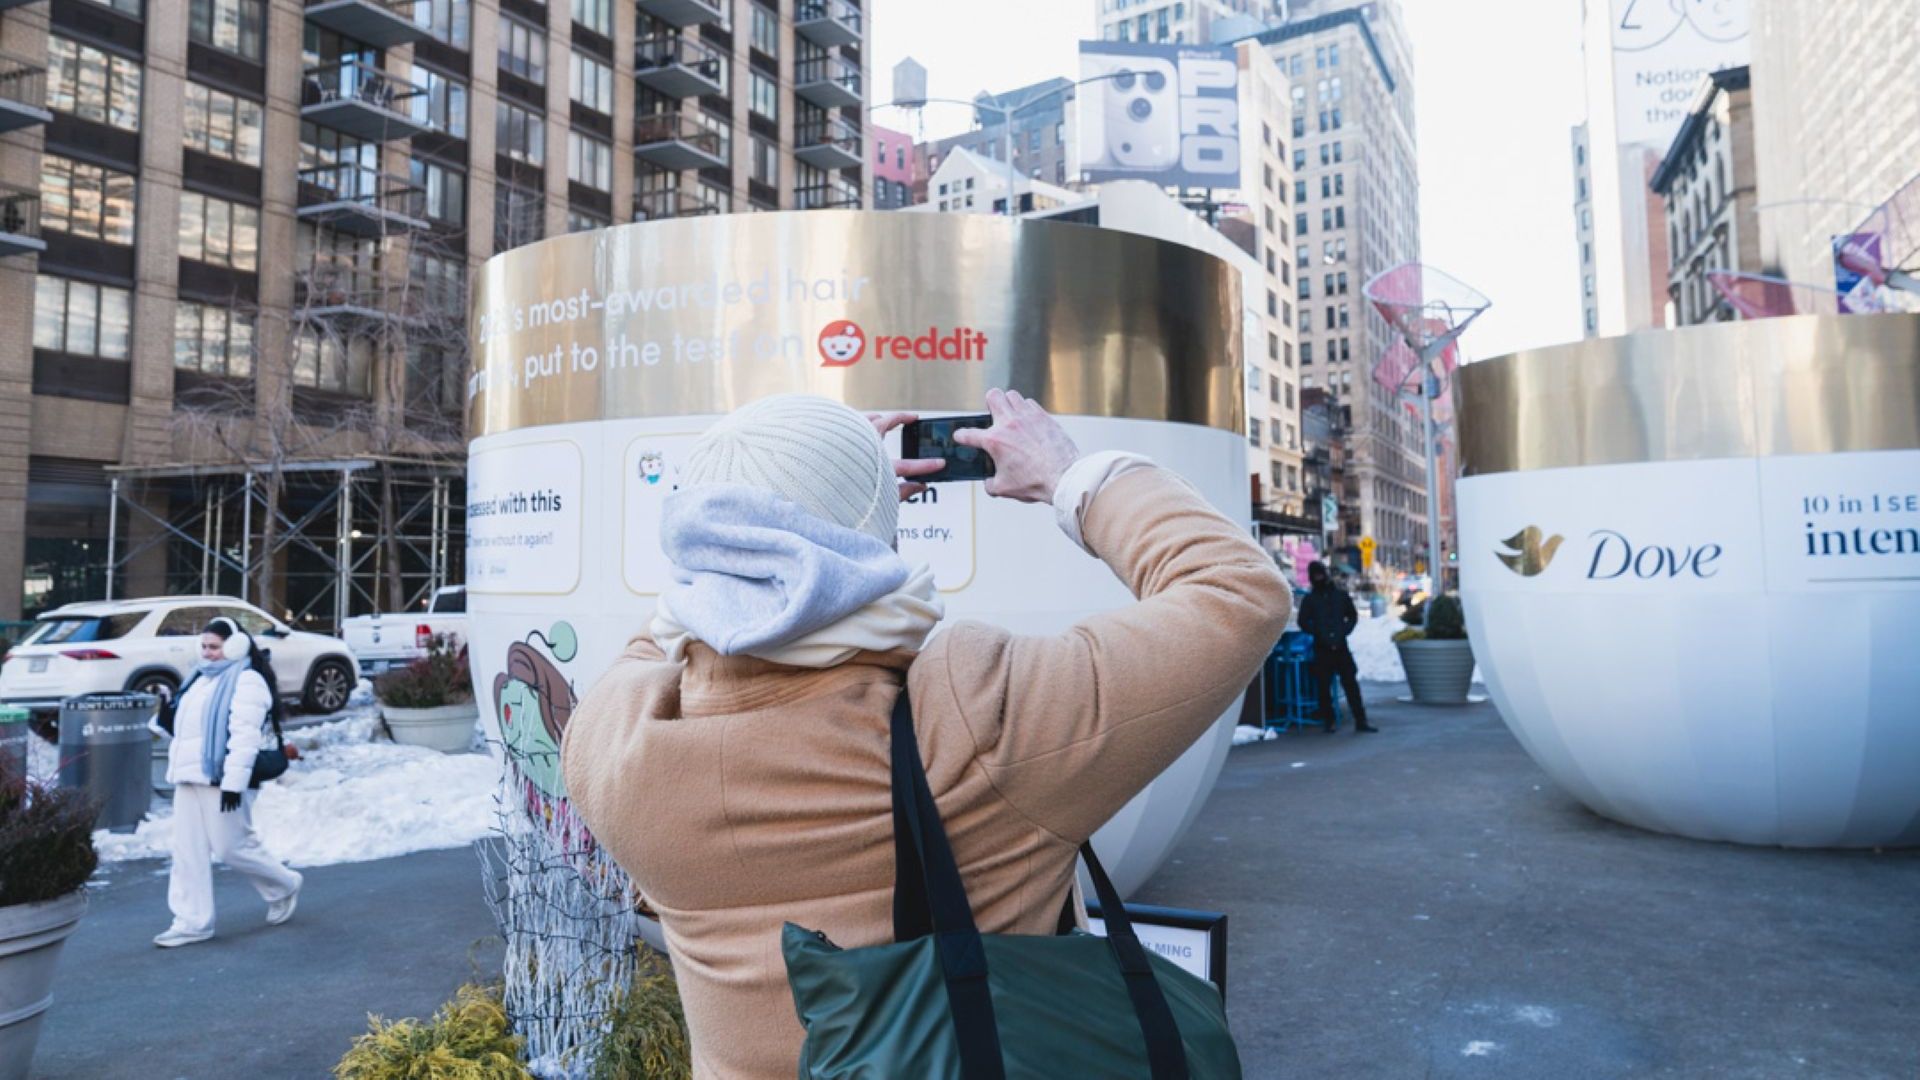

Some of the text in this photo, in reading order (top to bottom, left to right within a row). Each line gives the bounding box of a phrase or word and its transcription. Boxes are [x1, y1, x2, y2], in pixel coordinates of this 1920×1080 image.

[1179, 58, 1240, 174] PRO
[528, 268, 770, 328] most-awarded
[786, 267, 870, 302] hair
[524, 343, 564, 389] put
[570, 341, 598, 372] to
[607, 333, 661, 369] the
[672, 329, 740, 365] test
[751, 332, 805, 360] on
[875, 326, 988, 361] reddit
[499, 491, 528, 514] with
[531, 489, 562, 513] this
[1839, 494, 1862, 512] in
[1888, 495, 1918, 512] SE
[923, 524, 954, 543] dry.
[1586, 528, 1723, 580] Dove
